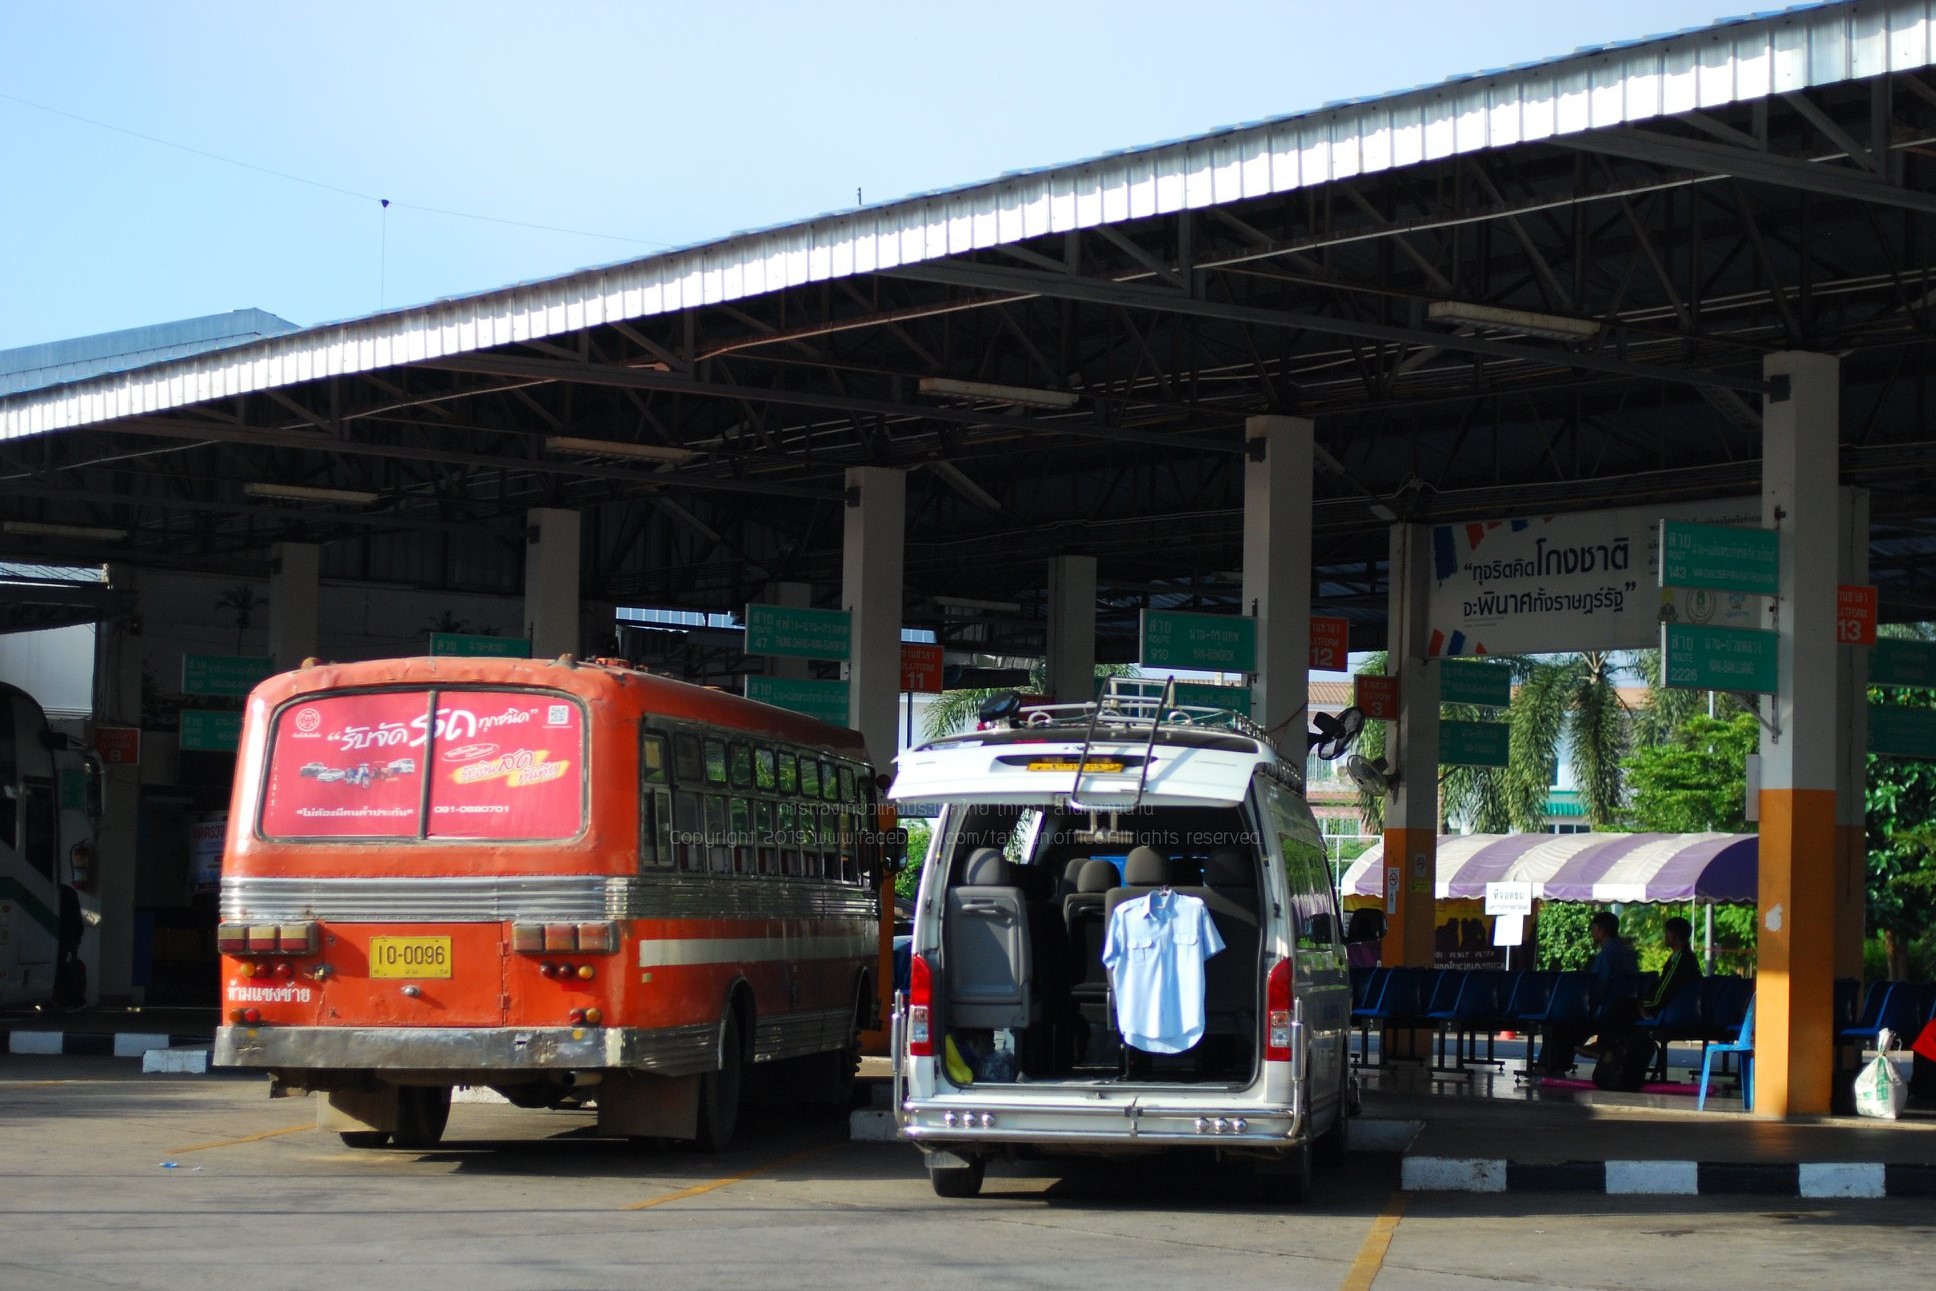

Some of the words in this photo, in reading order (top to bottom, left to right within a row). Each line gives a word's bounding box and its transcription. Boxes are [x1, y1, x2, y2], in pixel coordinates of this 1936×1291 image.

[1669, 565, 1687, 580] 143
[1839, 620, 1862, 641] 13
[755, 637, 768, 649] 47
[1150, 648, 1169, 661] 910
[1311, 647, 1333, 666] 12
[906, 672, 924, 689] 11
[1670, 667, 1698, 682] 2226
[377, 944, 446, 966] 10-0096
[227, 978, 311, 1003] ห้ามแซงซ้าย
